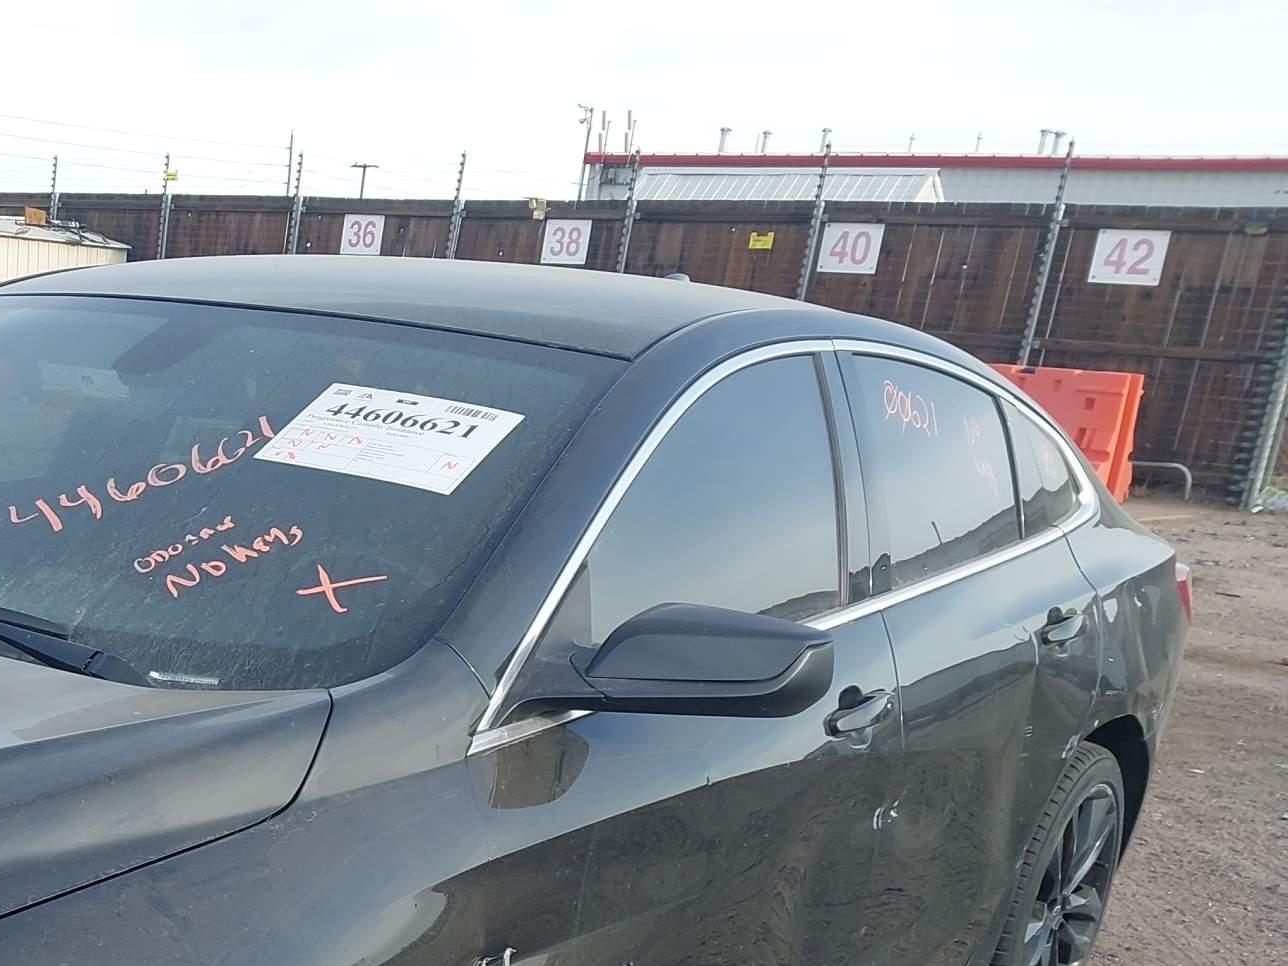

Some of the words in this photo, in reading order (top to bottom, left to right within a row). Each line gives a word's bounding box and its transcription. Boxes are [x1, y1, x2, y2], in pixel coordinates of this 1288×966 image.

[348, 220, 376, 248] 36
[550, 226, 582, 257] 38
[829, 230, 872, 265] 40
[1103, 238, 1154, 275] 42
[326, 402, 479, 438] 44606621
[8, 415, 275, 532] 44606621
